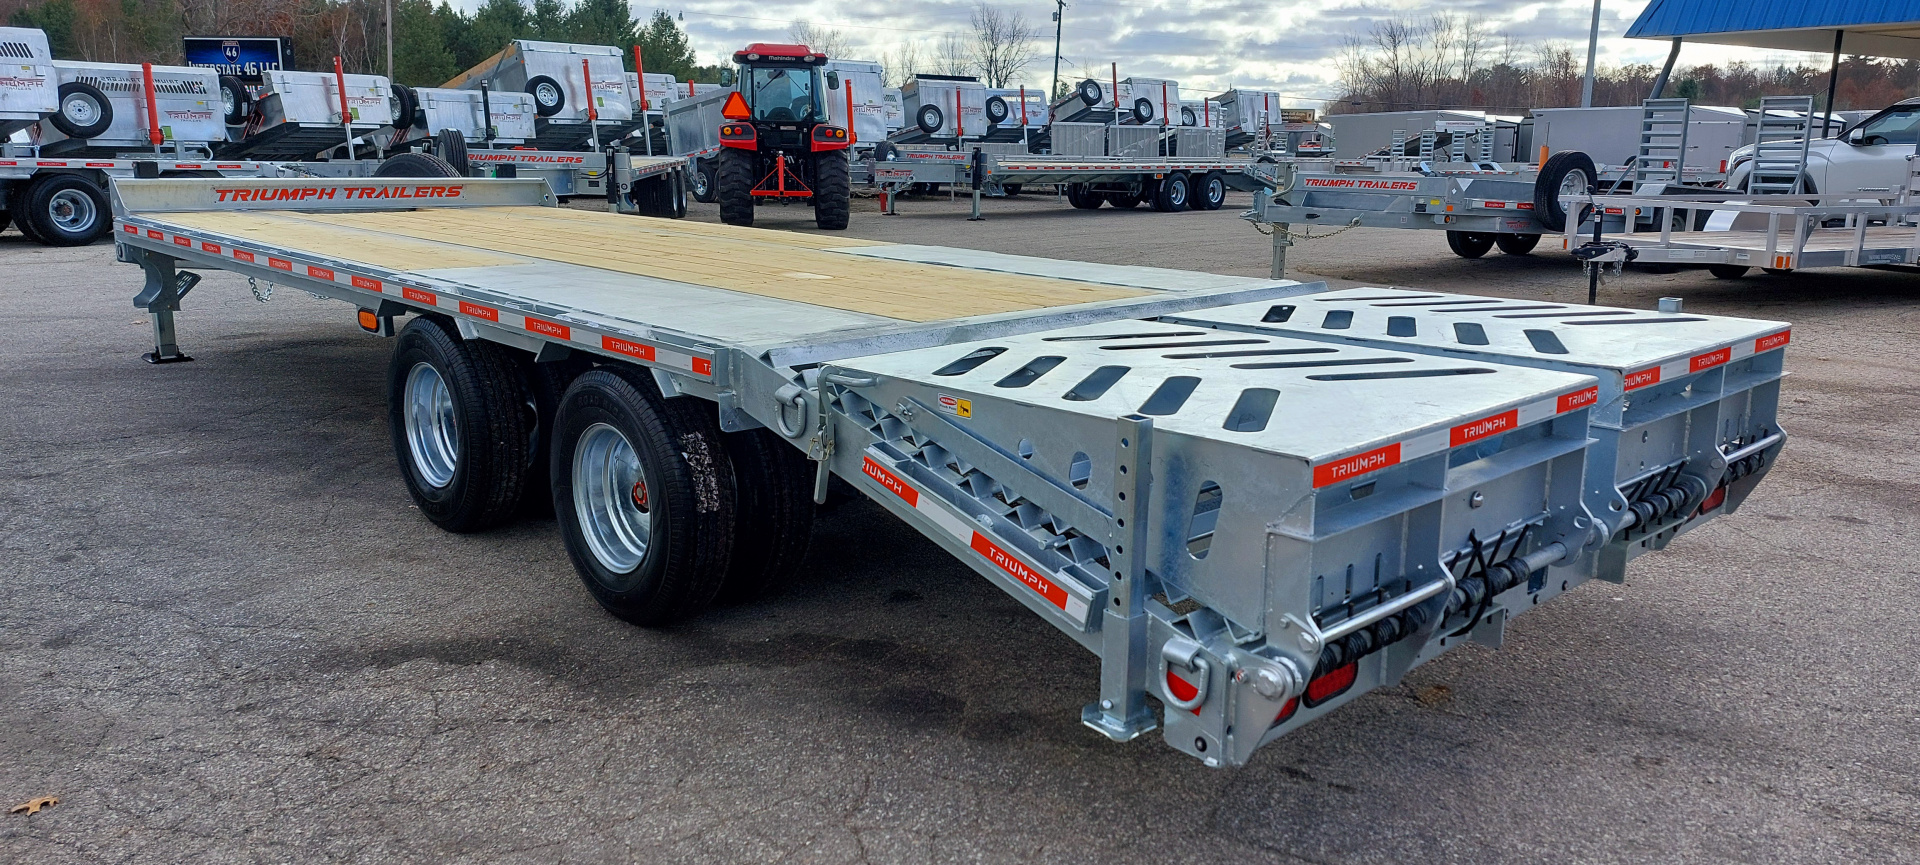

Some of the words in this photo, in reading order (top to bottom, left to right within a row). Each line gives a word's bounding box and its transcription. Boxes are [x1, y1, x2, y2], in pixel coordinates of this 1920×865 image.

[226, 47, 237, 57] 46
[243, 61, 258, 76] 46
[0, 80, 44, 88] RIUMPH
[592, 83, 622, 91] RIUMPH
[467, 153, 517, 162] RIUMPH
[520, 155, 584, 164] TRAILERS
[1305, 178, 1355, 188] TRIUMPH
[1358, 181, 1418, 190] TRAILERS
[215, 187, 337, 202] TRIUMPH
[343, 185, 464, 200] TRAILERS
[272, 259, 289, 270] TRIUMPH
[312, 268, 331, 278] TRIUMPH
[356, 278, 377, 290] TRIUMPH
[408, 291, 431, 303] TRIUMPH
[465, 305, 491, 318] TRIUMPH
[533, 321, 562, 335] TRIUMPH
[1762, 334, 1785, 348] TRIUMPH
[611, 340, 645, 356] TRIUMPH
[1698, 352, 1724, 367] TRIUMPH
[1568, 389, 1598, 407] TRIUMP
[1463, 416, 1507, 439] TRIUMPH
[1331, 452, 1386, 479] TRIUMPH
[989, 546, 1048, 594] TRIUMPH
